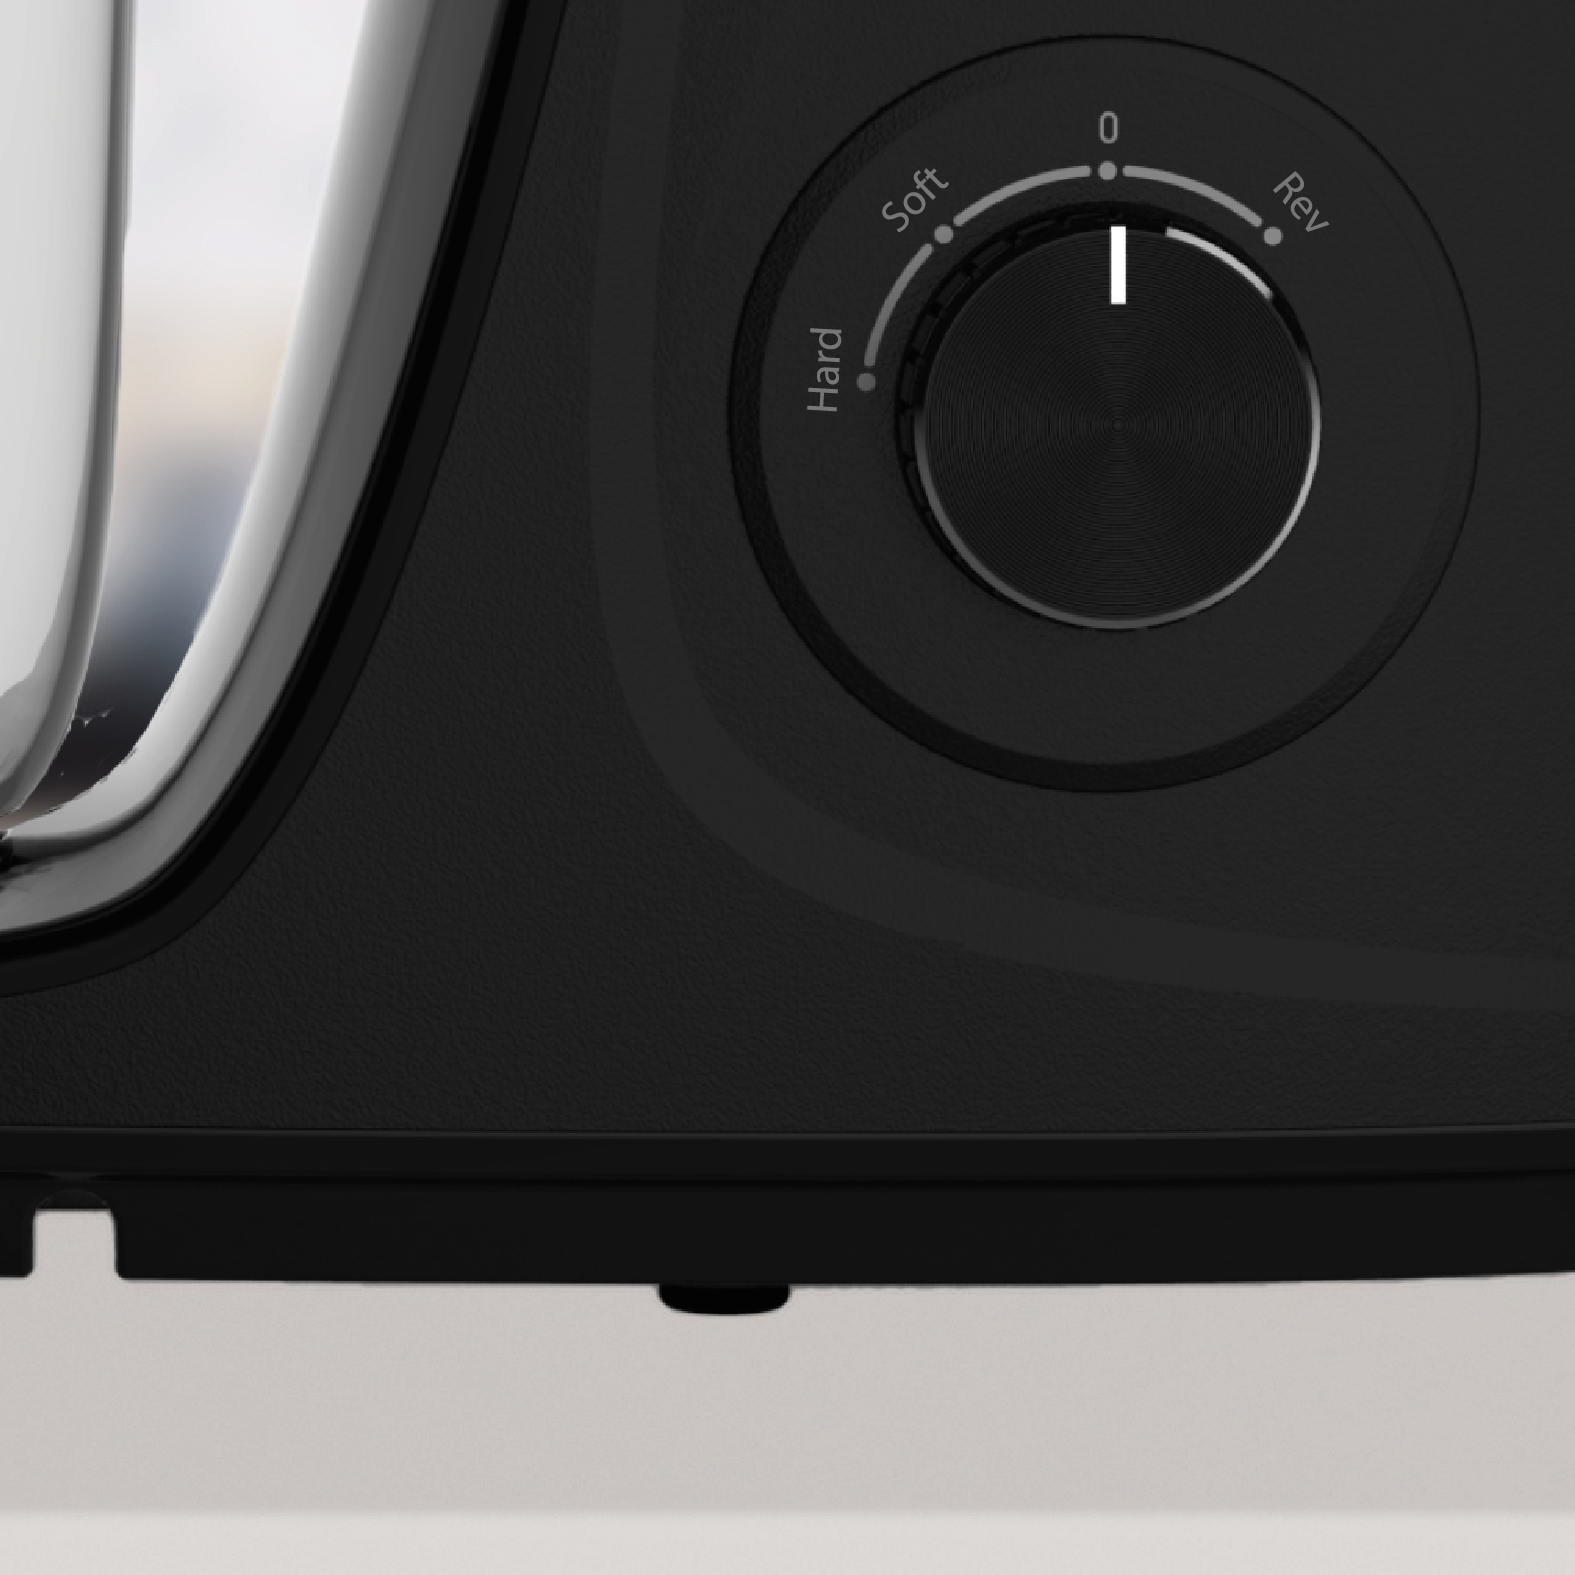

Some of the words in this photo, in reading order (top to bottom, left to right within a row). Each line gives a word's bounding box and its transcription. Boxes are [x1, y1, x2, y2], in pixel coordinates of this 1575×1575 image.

[1099, 111, 1119, 145] 0
[881, 166, 949, 233] Soft
[1272, 171, 1330, 236] Rev
[807, 327, 842, 412] Hard
